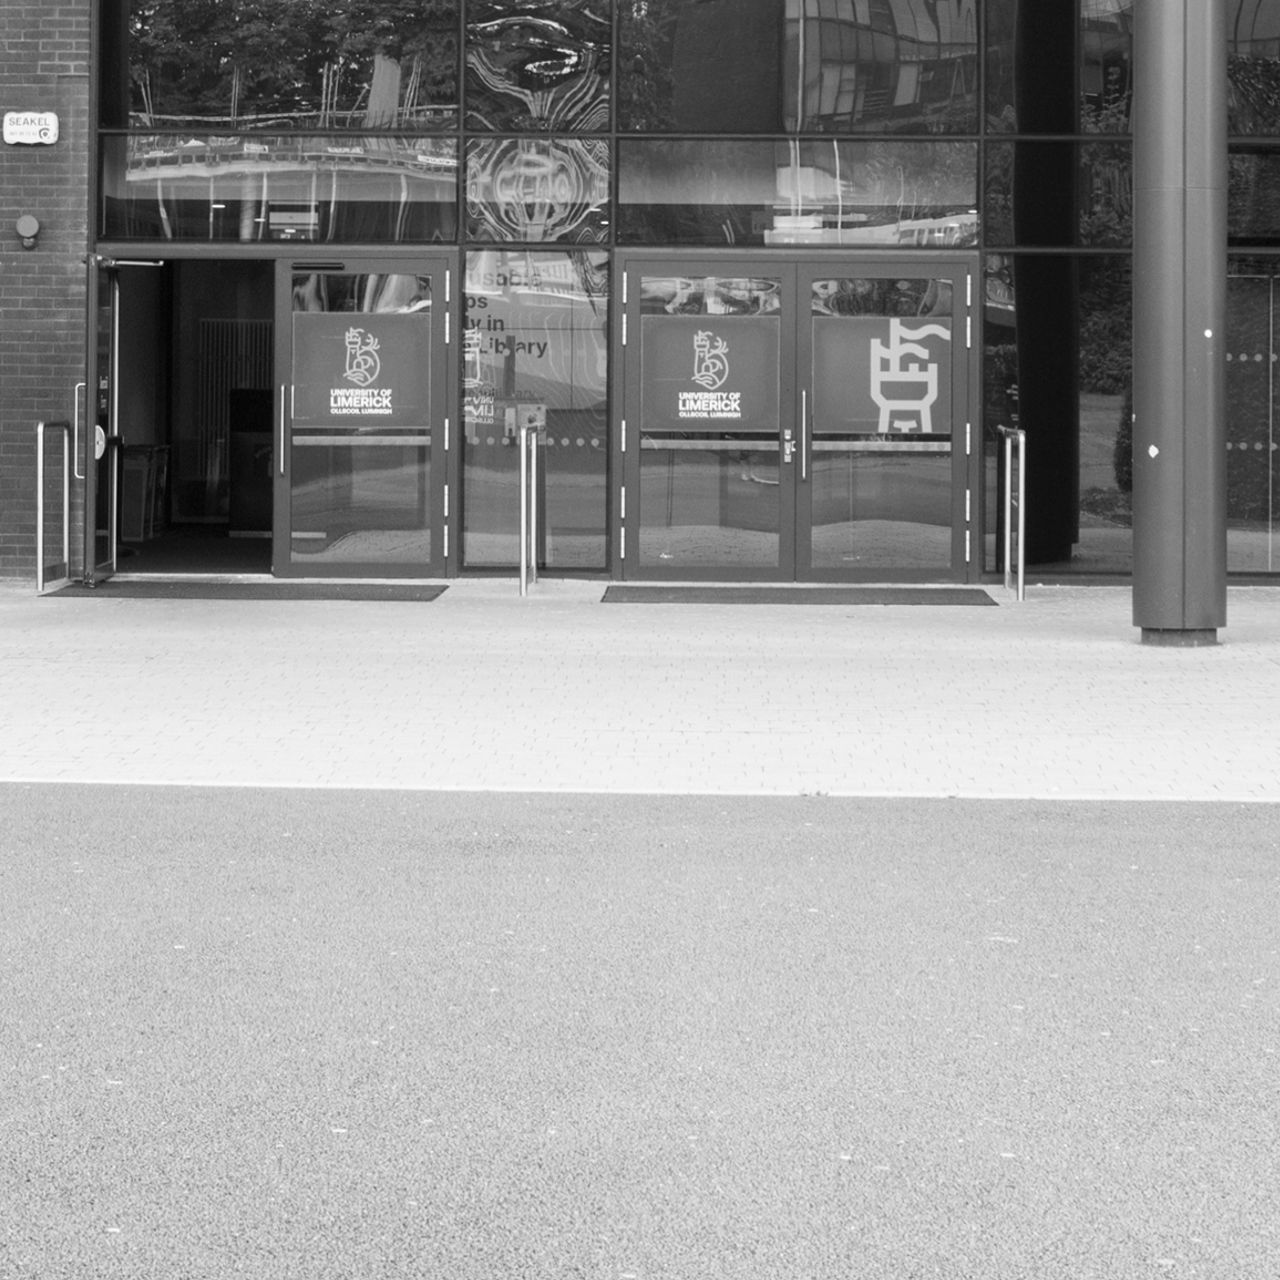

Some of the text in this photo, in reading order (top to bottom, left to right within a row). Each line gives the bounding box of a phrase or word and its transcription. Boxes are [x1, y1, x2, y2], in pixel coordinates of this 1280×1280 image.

[487, 315, 505, 332] in
[479, 338, 548, 359] Libary
[330, 388, 392, 397] UNIVERSITY OF
[678, 391, 741, 400] UNIVERSITY OF
[330, 396, 392, 408] LIMERICK
[678, 400, 741, 411] LIMERICK
